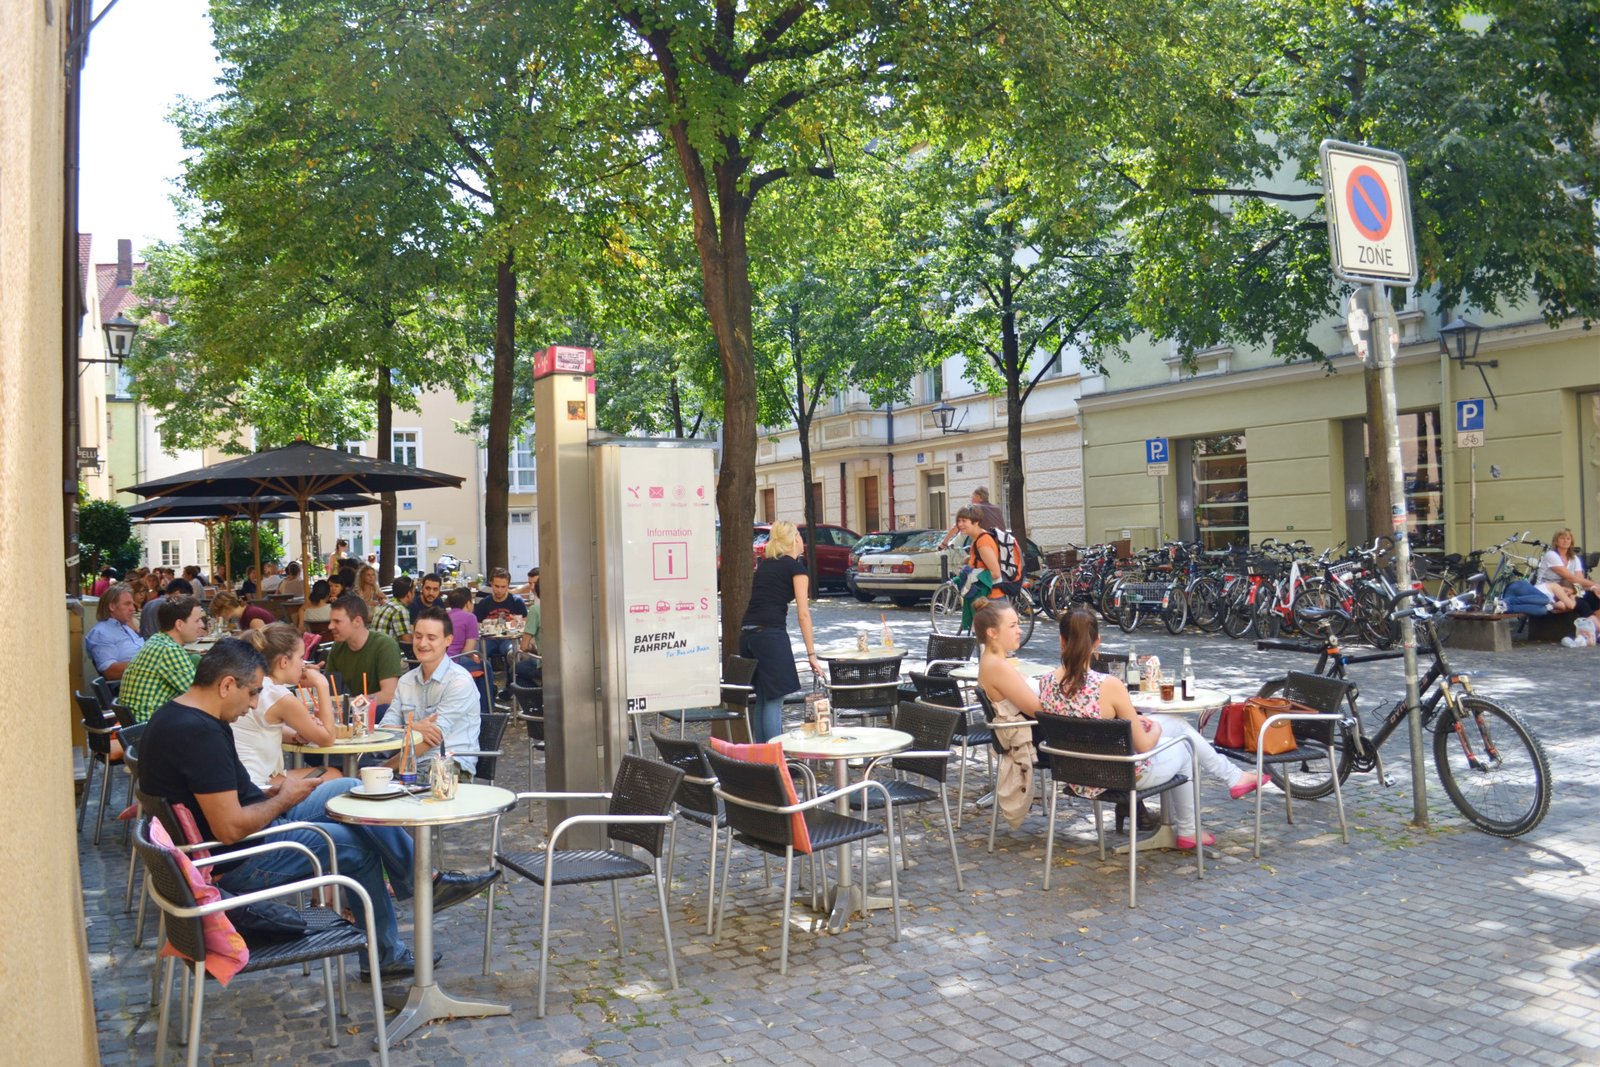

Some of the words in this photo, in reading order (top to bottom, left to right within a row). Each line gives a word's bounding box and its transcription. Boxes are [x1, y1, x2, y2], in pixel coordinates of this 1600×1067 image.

[1358, 245, 1393, 266] ZONE
[1462, 403, 1478, 428] P
[1150, 441, 1163, 460] P
[647, 528, 692, 536] Information
[634, 631, 675, 644] BAYERN
[633, 640, 687, 654] FAHRPLAN
